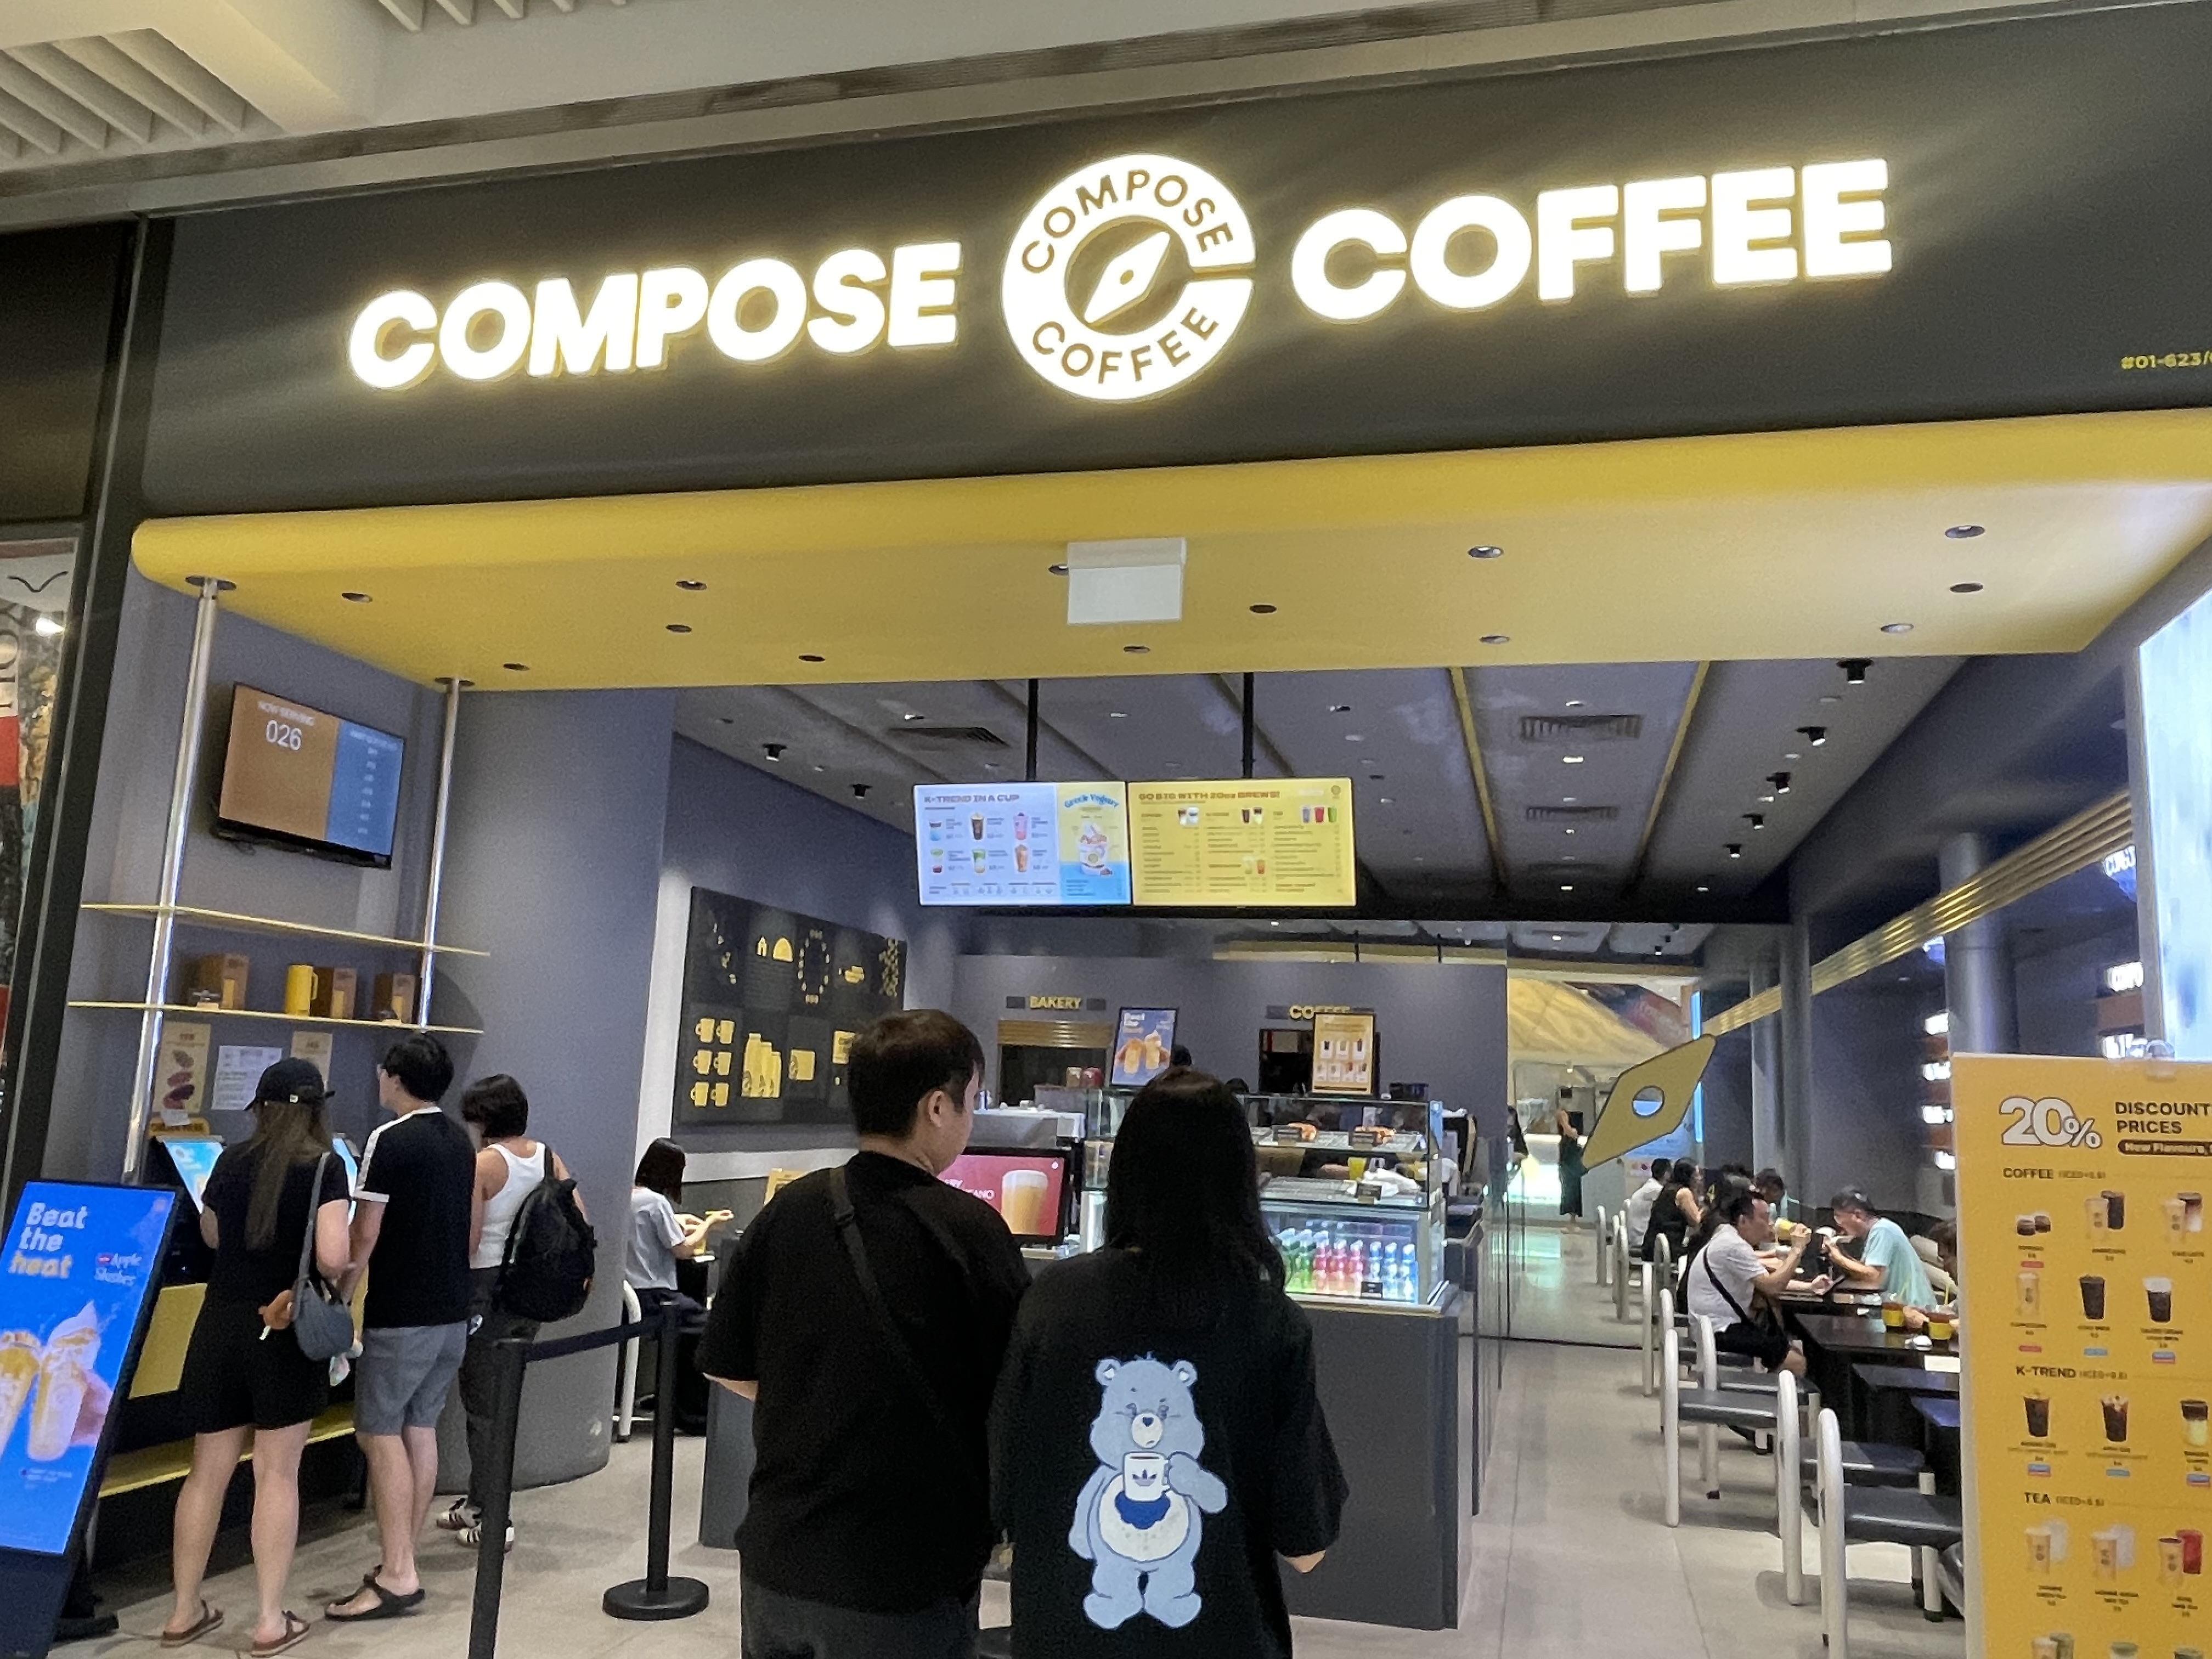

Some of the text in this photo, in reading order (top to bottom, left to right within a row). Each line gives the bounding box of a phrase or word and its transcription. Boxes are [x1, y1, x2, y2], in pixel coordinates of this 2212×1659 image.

[1021, 168, 1234, 274] COMPOSE
[1291, 158, 1893, 321] COFFEE
[349, 241, 961, 388] COMPOSE
[1032, 306, 1220, 385] COFFEE
[2120, 350, 2212, 370] #01-623/
[266, 719, 303, 751] 026
[1029, 995, 1082, 1009] BAKERY
[1998, 1096, 2103, 1149] 20%
[2116, 1119, 2182, 1135] PRICES
[2003, 1167, 2054, 1180] COFFEE
[27, 1201, 89, 1229] Beat
[19, 1227, 64, 1252] the
[8, 1250, 73, 1279] heat
[2016, 1365, 2076, 1378] K-TREND
[2024, 1491, 2051, 1504] TEA
